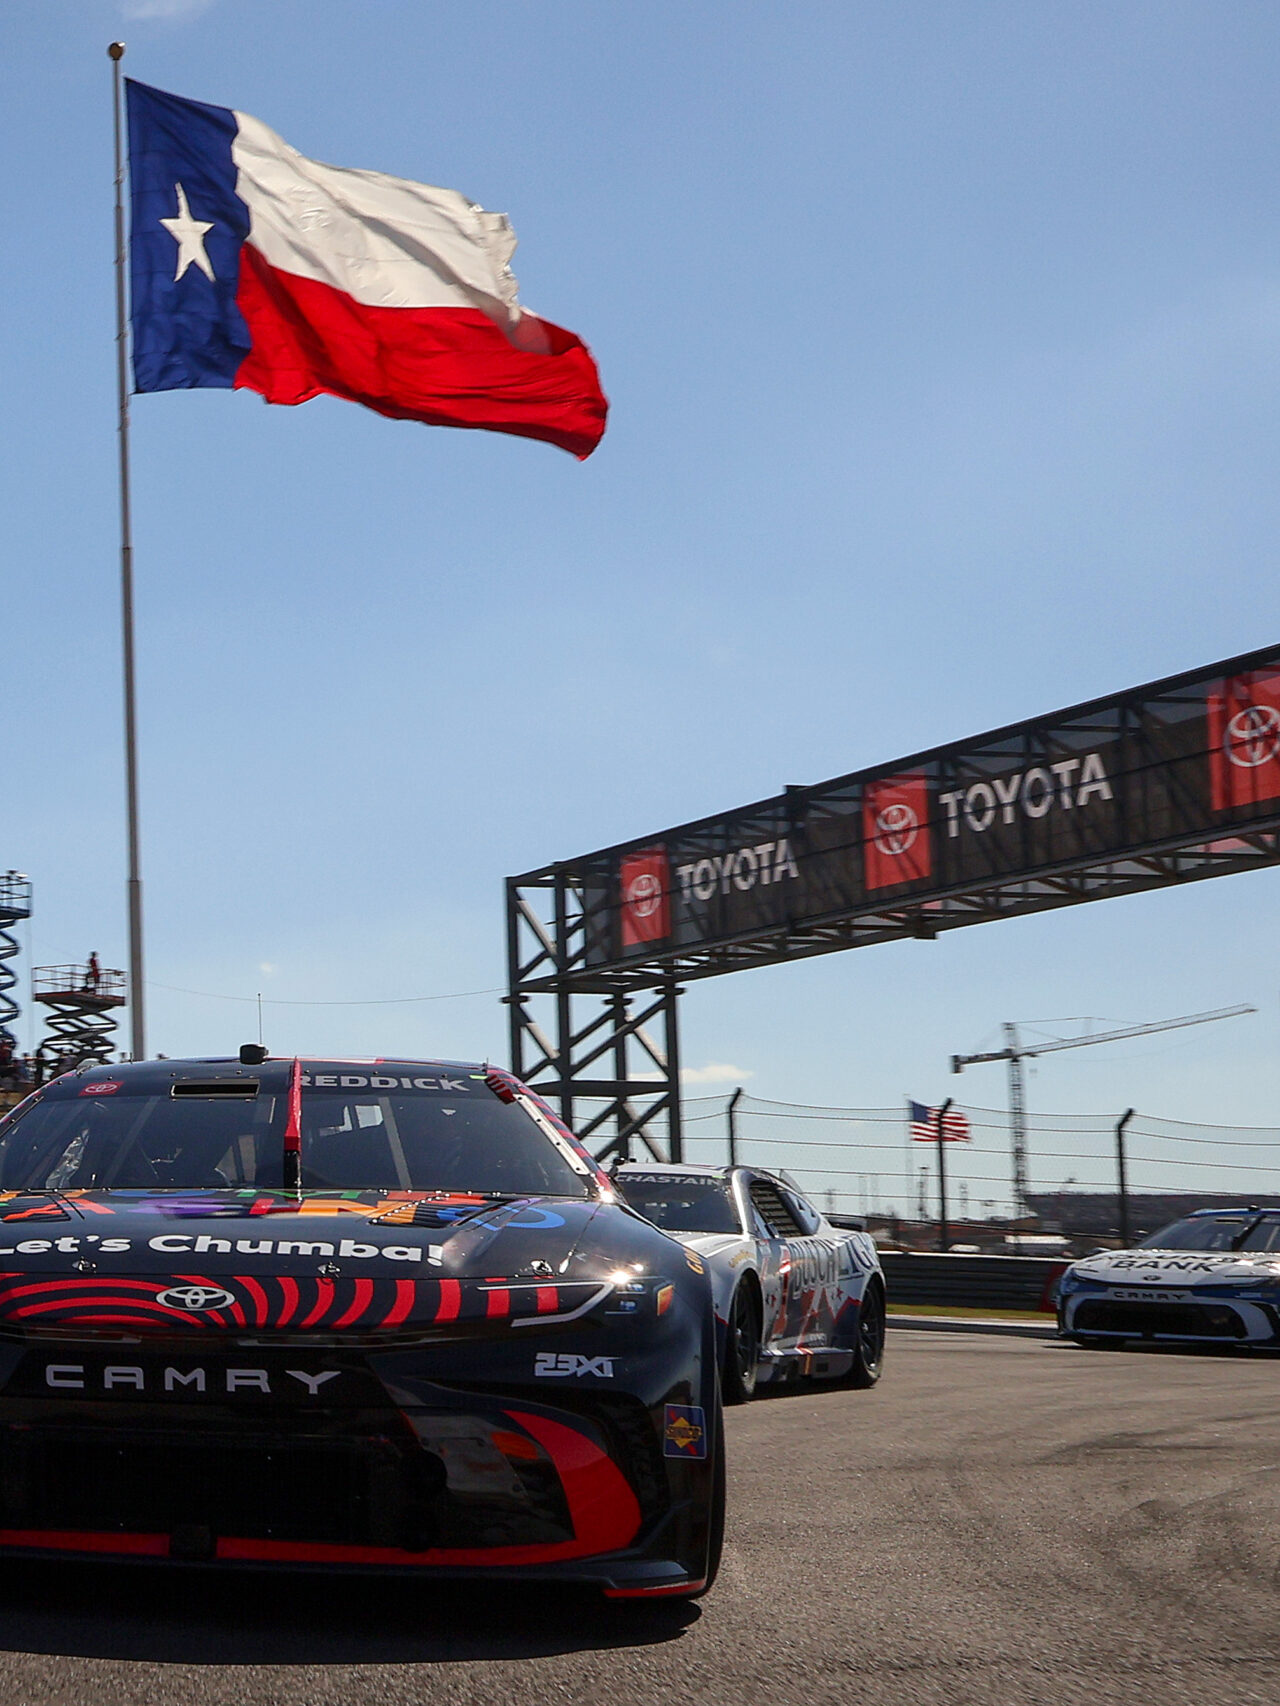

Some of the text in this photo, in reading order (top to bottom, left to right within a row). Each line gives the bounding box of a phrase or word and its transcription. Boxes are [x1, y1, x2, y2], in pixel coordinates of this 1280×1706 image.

[939, 753, 1113, 838] TOYOTA
[675, 839, 799, 905] TOYOTA
[149, 1235, 443, 1267] Chumba!
[1111, 1259, 1220, 1273] BANK
[1113, 1291, 1187, 1301] CAMRY
[46, 1363, 342, 1395] CAMRY
[534, 1352, 622, 1378] 23XI
